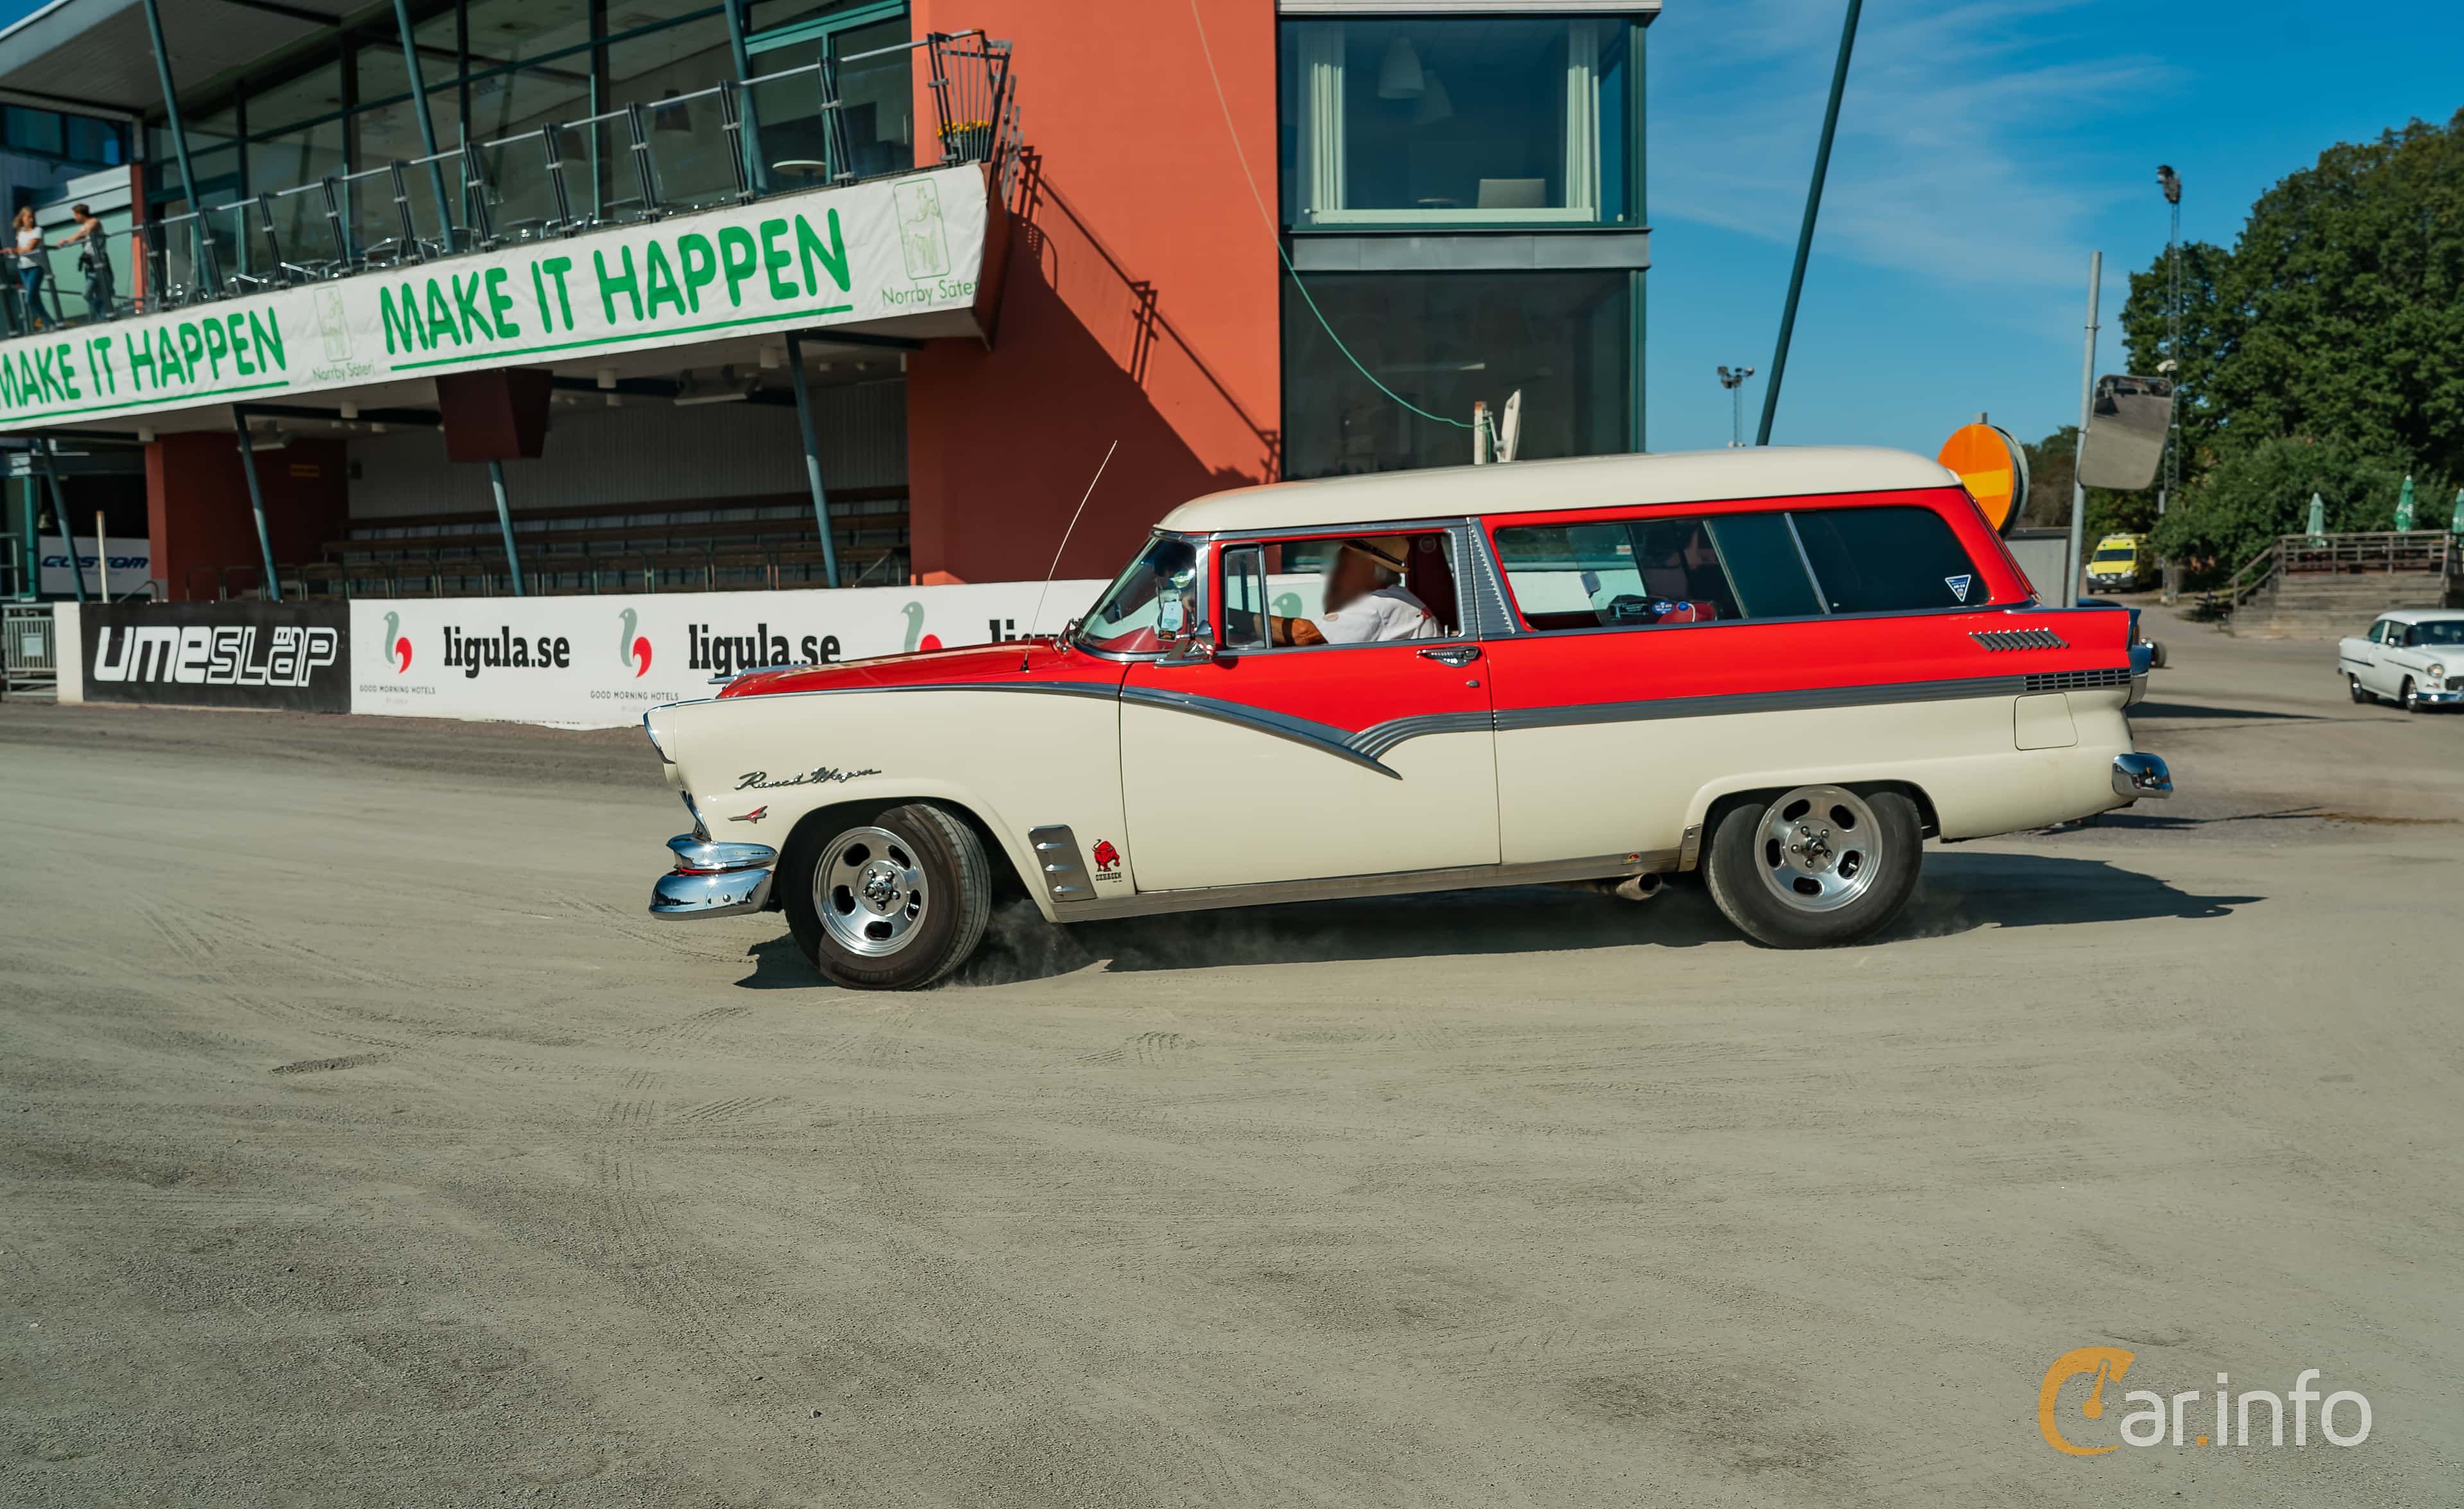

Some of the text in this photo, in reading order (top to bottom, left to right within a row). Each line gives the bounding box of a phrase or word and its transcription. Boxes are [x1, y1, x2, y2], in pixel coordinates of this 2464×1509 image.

[380, 208, 850, 355] MAKE IT HAPPEN
[882, 282, 933, 306] Norrby
[0, 307, 286, 408] MAKE IT HAPPEN
[312, 364, 346, 381] Norrby
[444, 626, 570, 678] ligula.se
[689, 623, 841, 678] ligula.se
[359, 685, 436, 694] GOOD MORNING HOTELS
[590, 690, 679, 701] GOOD MORNING HOTELS
